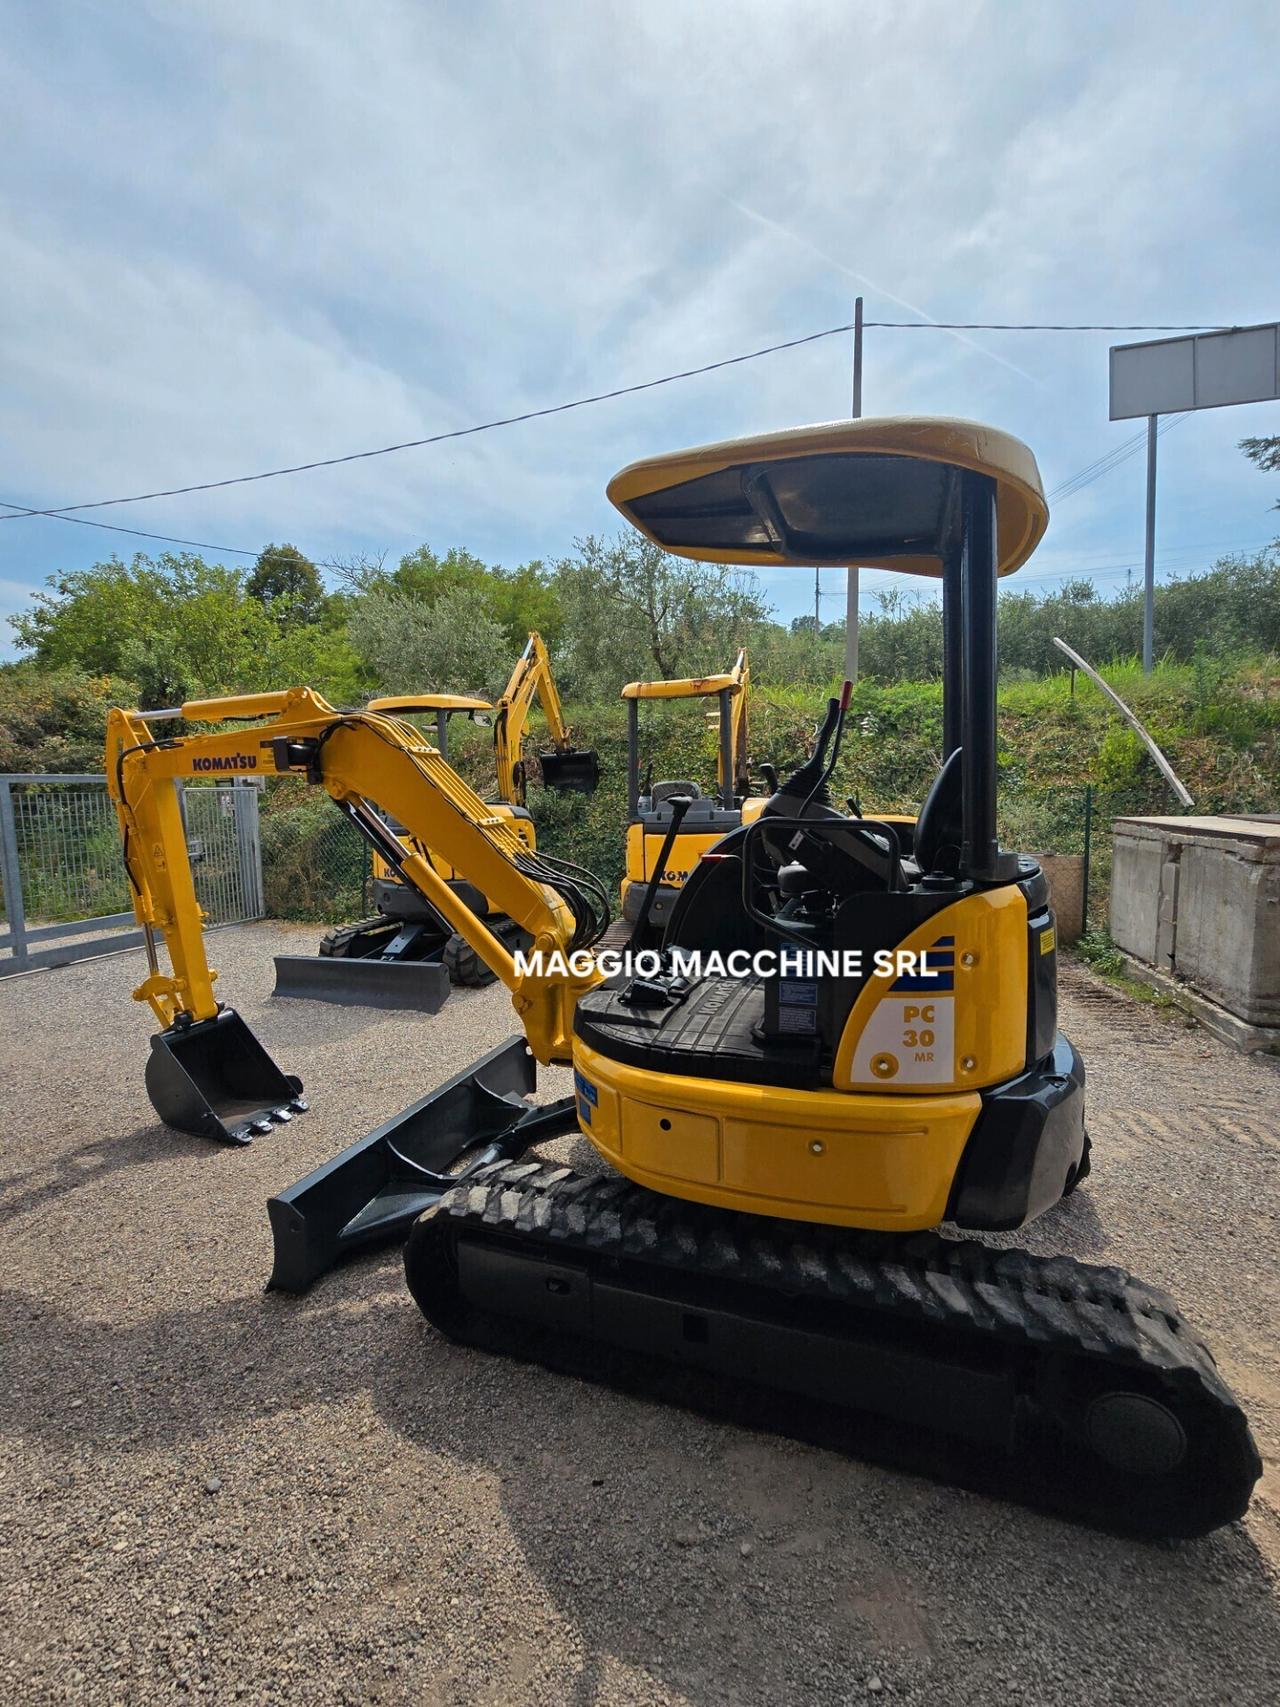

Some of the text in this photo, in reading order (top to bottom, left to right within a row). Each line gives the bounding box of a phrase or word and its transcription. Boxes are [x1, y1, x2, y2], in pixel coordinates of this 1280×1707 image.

[192, 753, 257, 771] KOMATSU
[903, 1005, 935, 1023] PC
[902, 1029, 935, 1048] 30
[914, 1052, 934, 1063] MR
